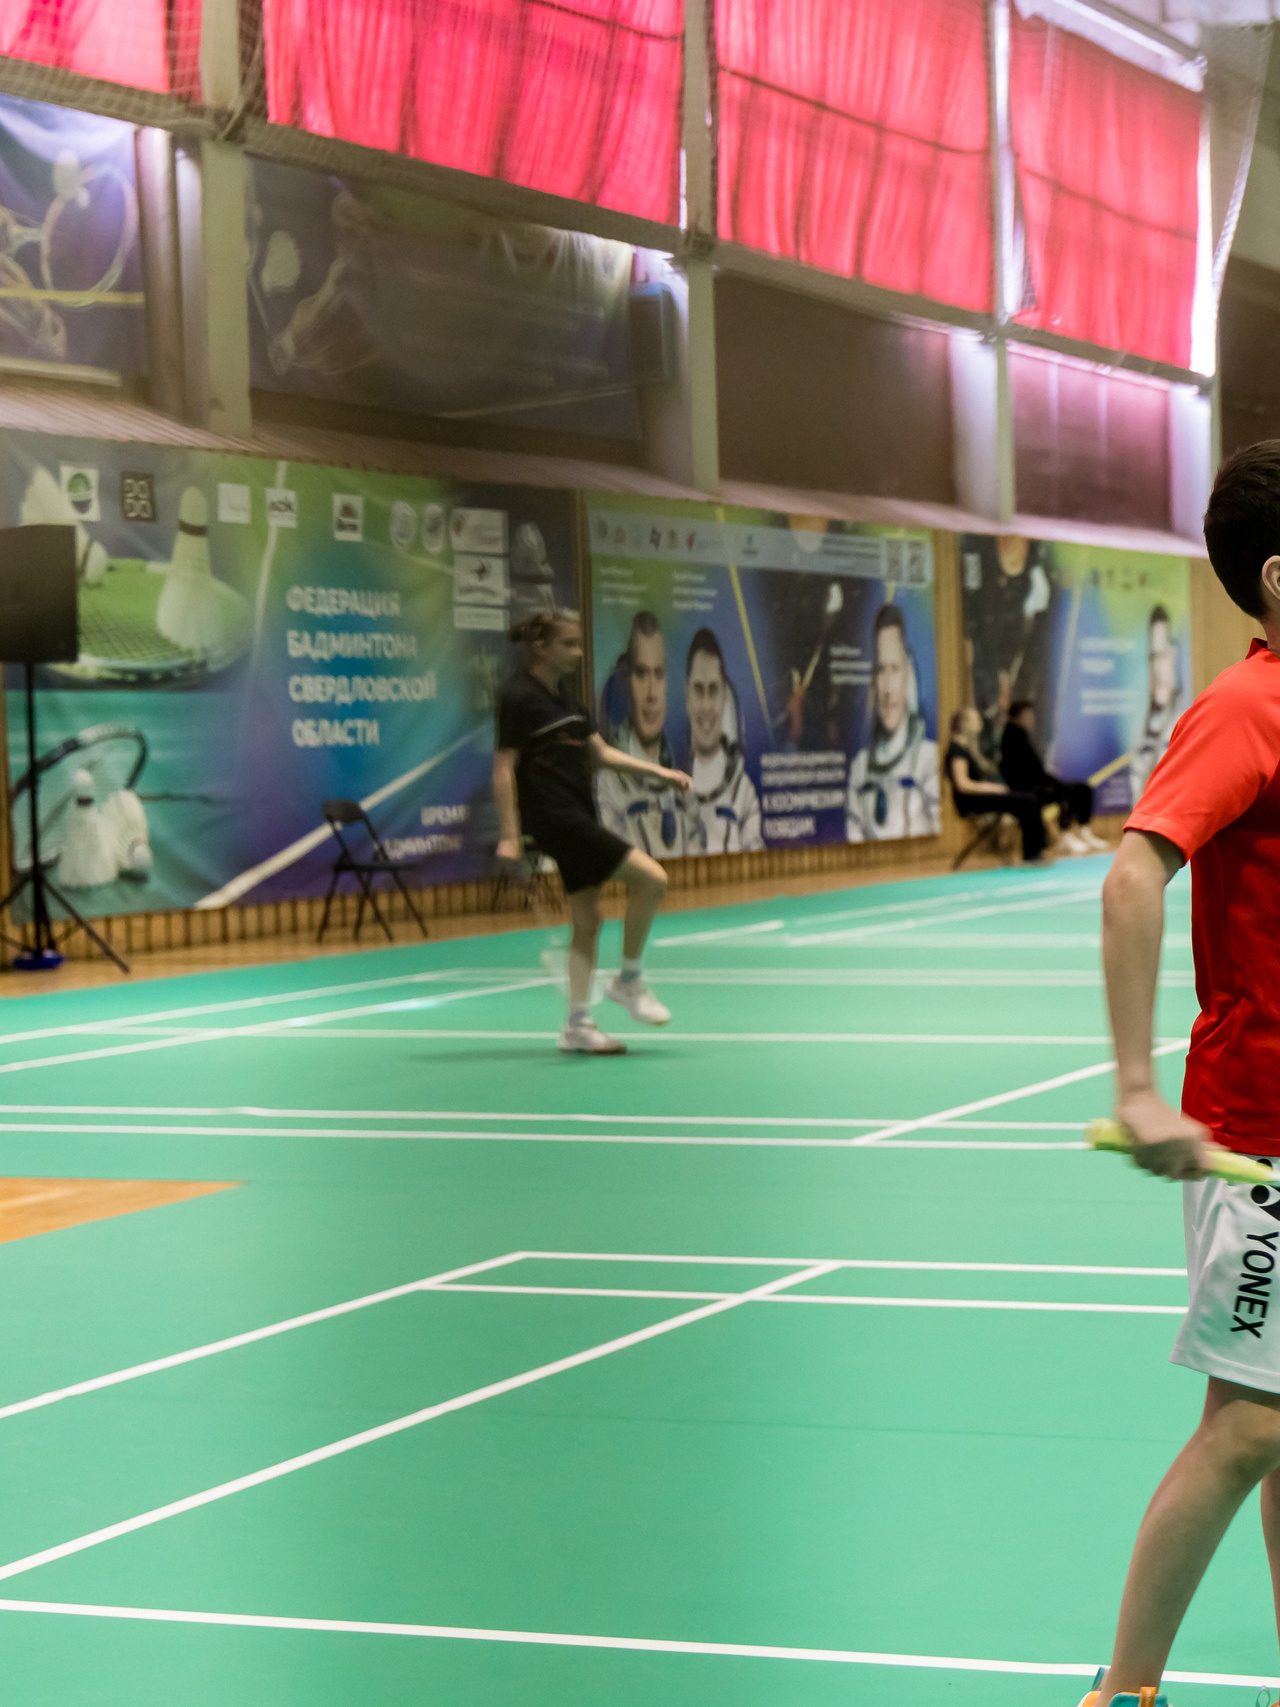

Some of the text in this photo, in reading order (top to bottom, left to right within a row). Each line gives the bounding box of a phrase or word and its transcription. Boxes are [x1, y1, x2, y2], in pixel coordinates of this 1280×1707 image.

[287, 585, 400, 620] ФЕДЕРАЦИЯ
[287, 629, 417, 663] БАДМИНТОНА
[289, 670, 437, 707] СВЕРДЛОВСКОЙ
[292, 717, 380, 748] ОБЛАСТИ
[1230, 1231, 1280, 1339] YONEX
